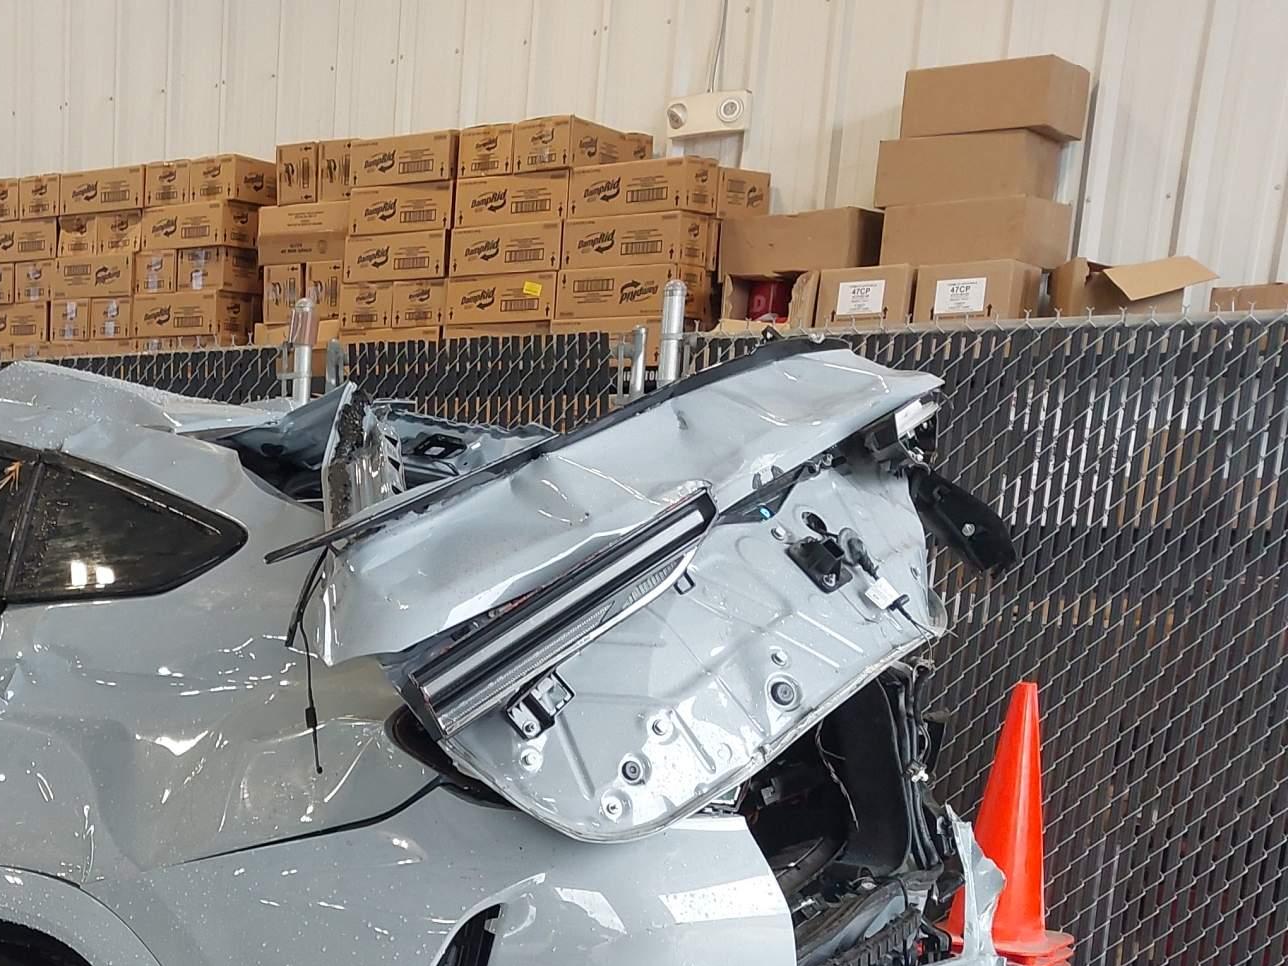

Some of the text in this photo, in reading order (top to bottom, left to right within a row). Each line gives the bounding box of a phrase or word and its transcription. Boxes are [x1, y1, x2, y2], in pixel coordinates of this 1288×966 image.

[364, 149, 397, 169] DampRid
[584, 176, 622, 199] DampRid
[364, 198, 398, 217] DampRid
[470, 188, 508, 209] DampRid
[464, 237, 501, 257] DampRid
[577, 229, 616, 250] DampRid
[357, 246, 390, 265] DampRid
[461, 286, 497, 306] DampRid
